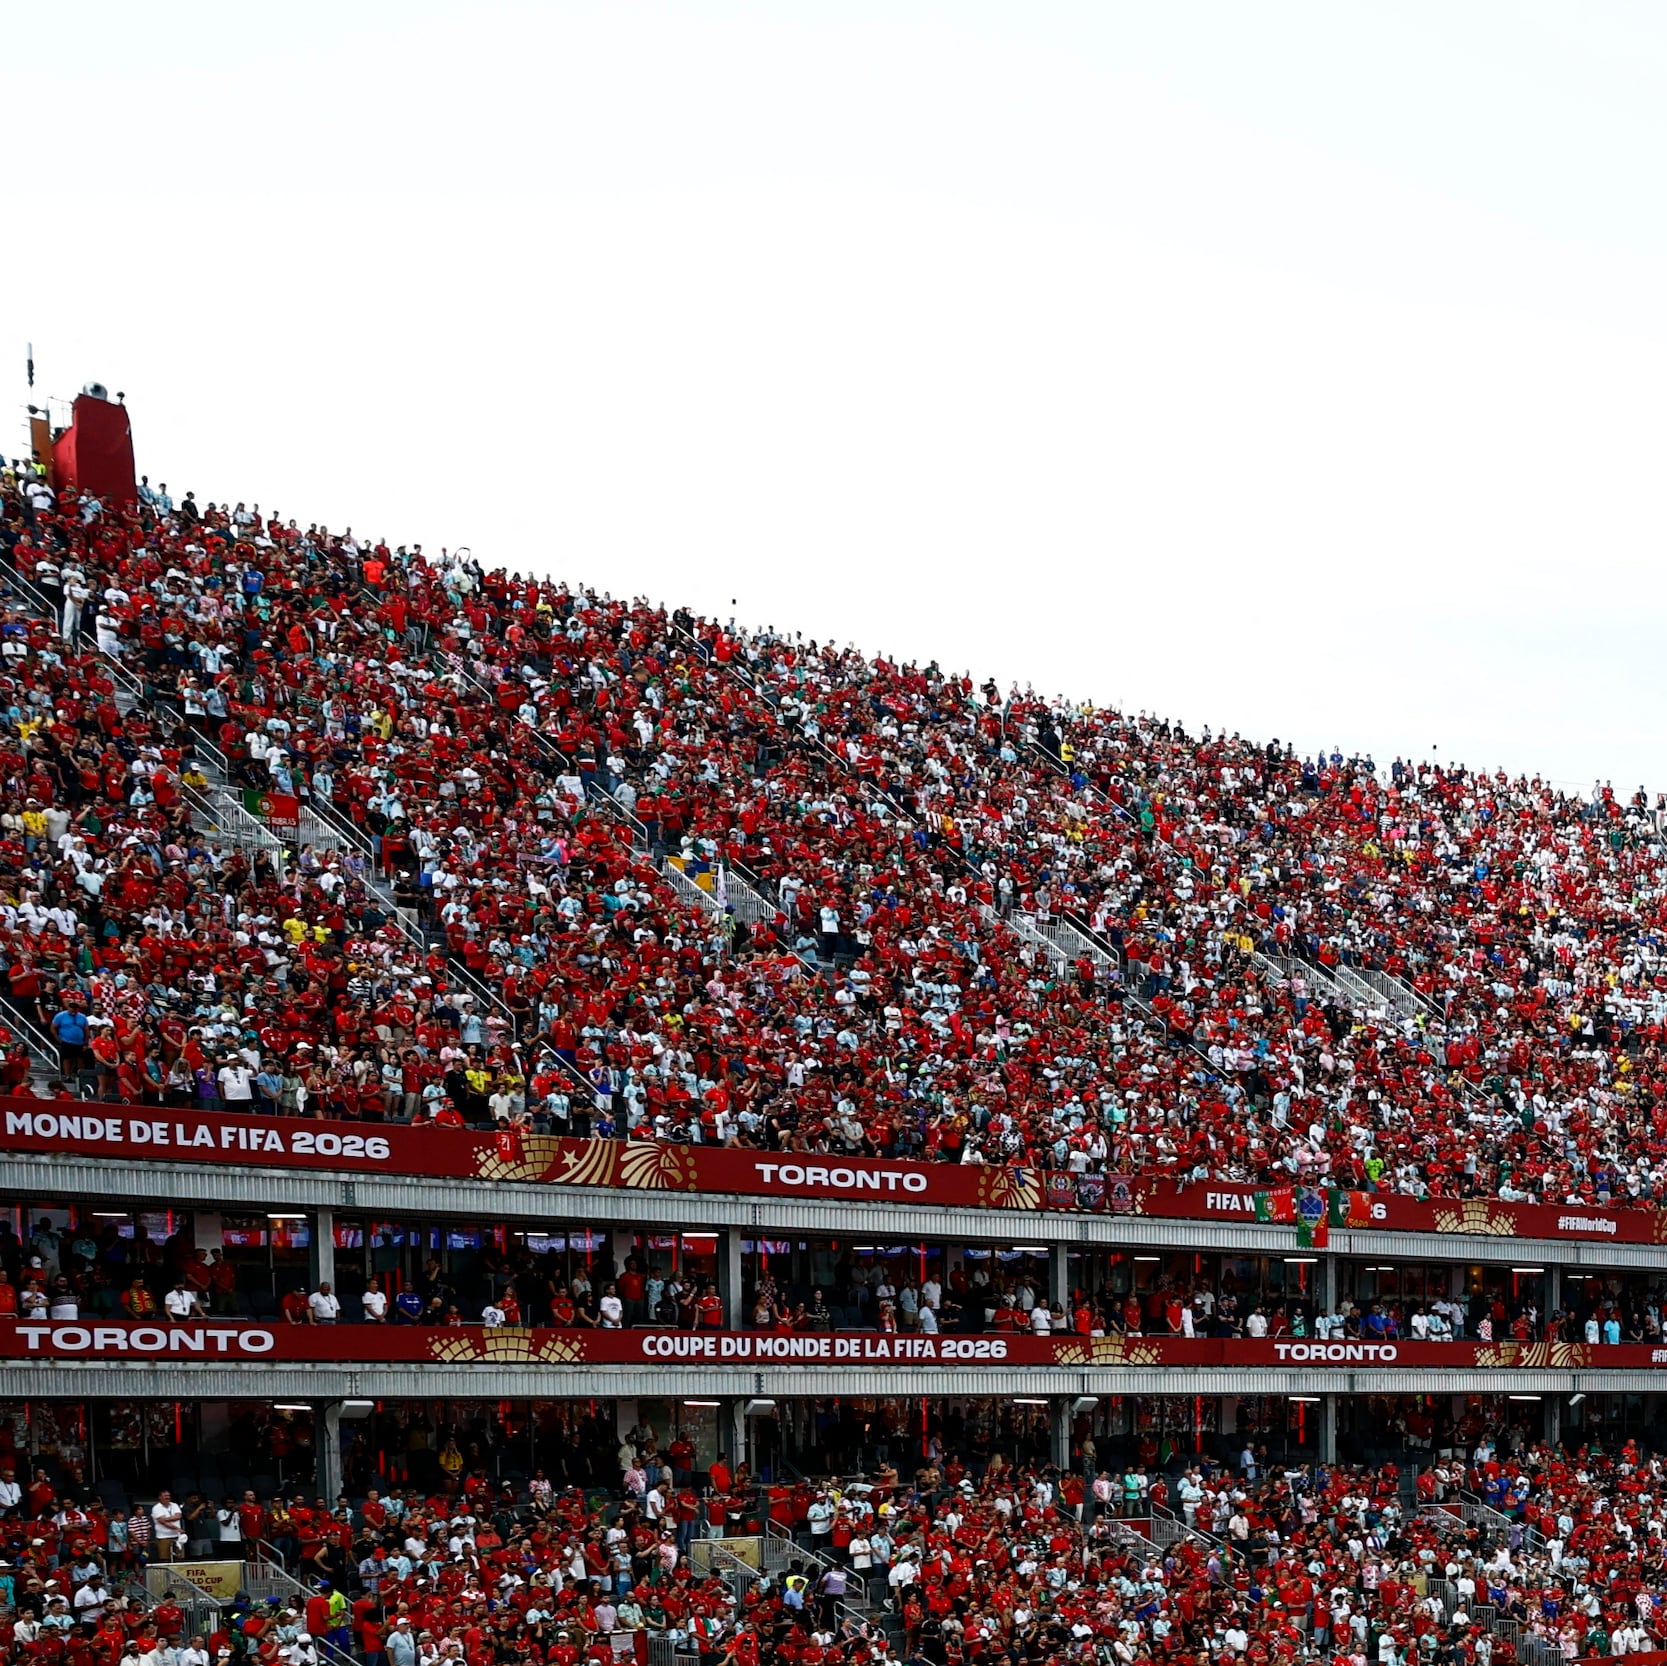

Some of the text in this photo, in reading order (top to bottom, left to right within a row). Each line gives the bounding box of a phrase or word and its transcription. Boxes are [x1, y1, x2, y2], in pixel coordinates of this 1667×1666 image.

[6, 1112, 391, 1159] MONDE DE LA FIFA 2026
[755, 1163, 928, 1192] TORONTO
[1207, 1192, 1241, 1211] FIFA
[1558, 1216, 1617, 1234] #FIFAWorldCup
[16, 1327, 275, 1352] TORONTO
[642, 1335, 1008, 1359] COUPE DU MONDE DE LA FIFA 2026
[1274, 1344, 1398, 1361] TORONTO
